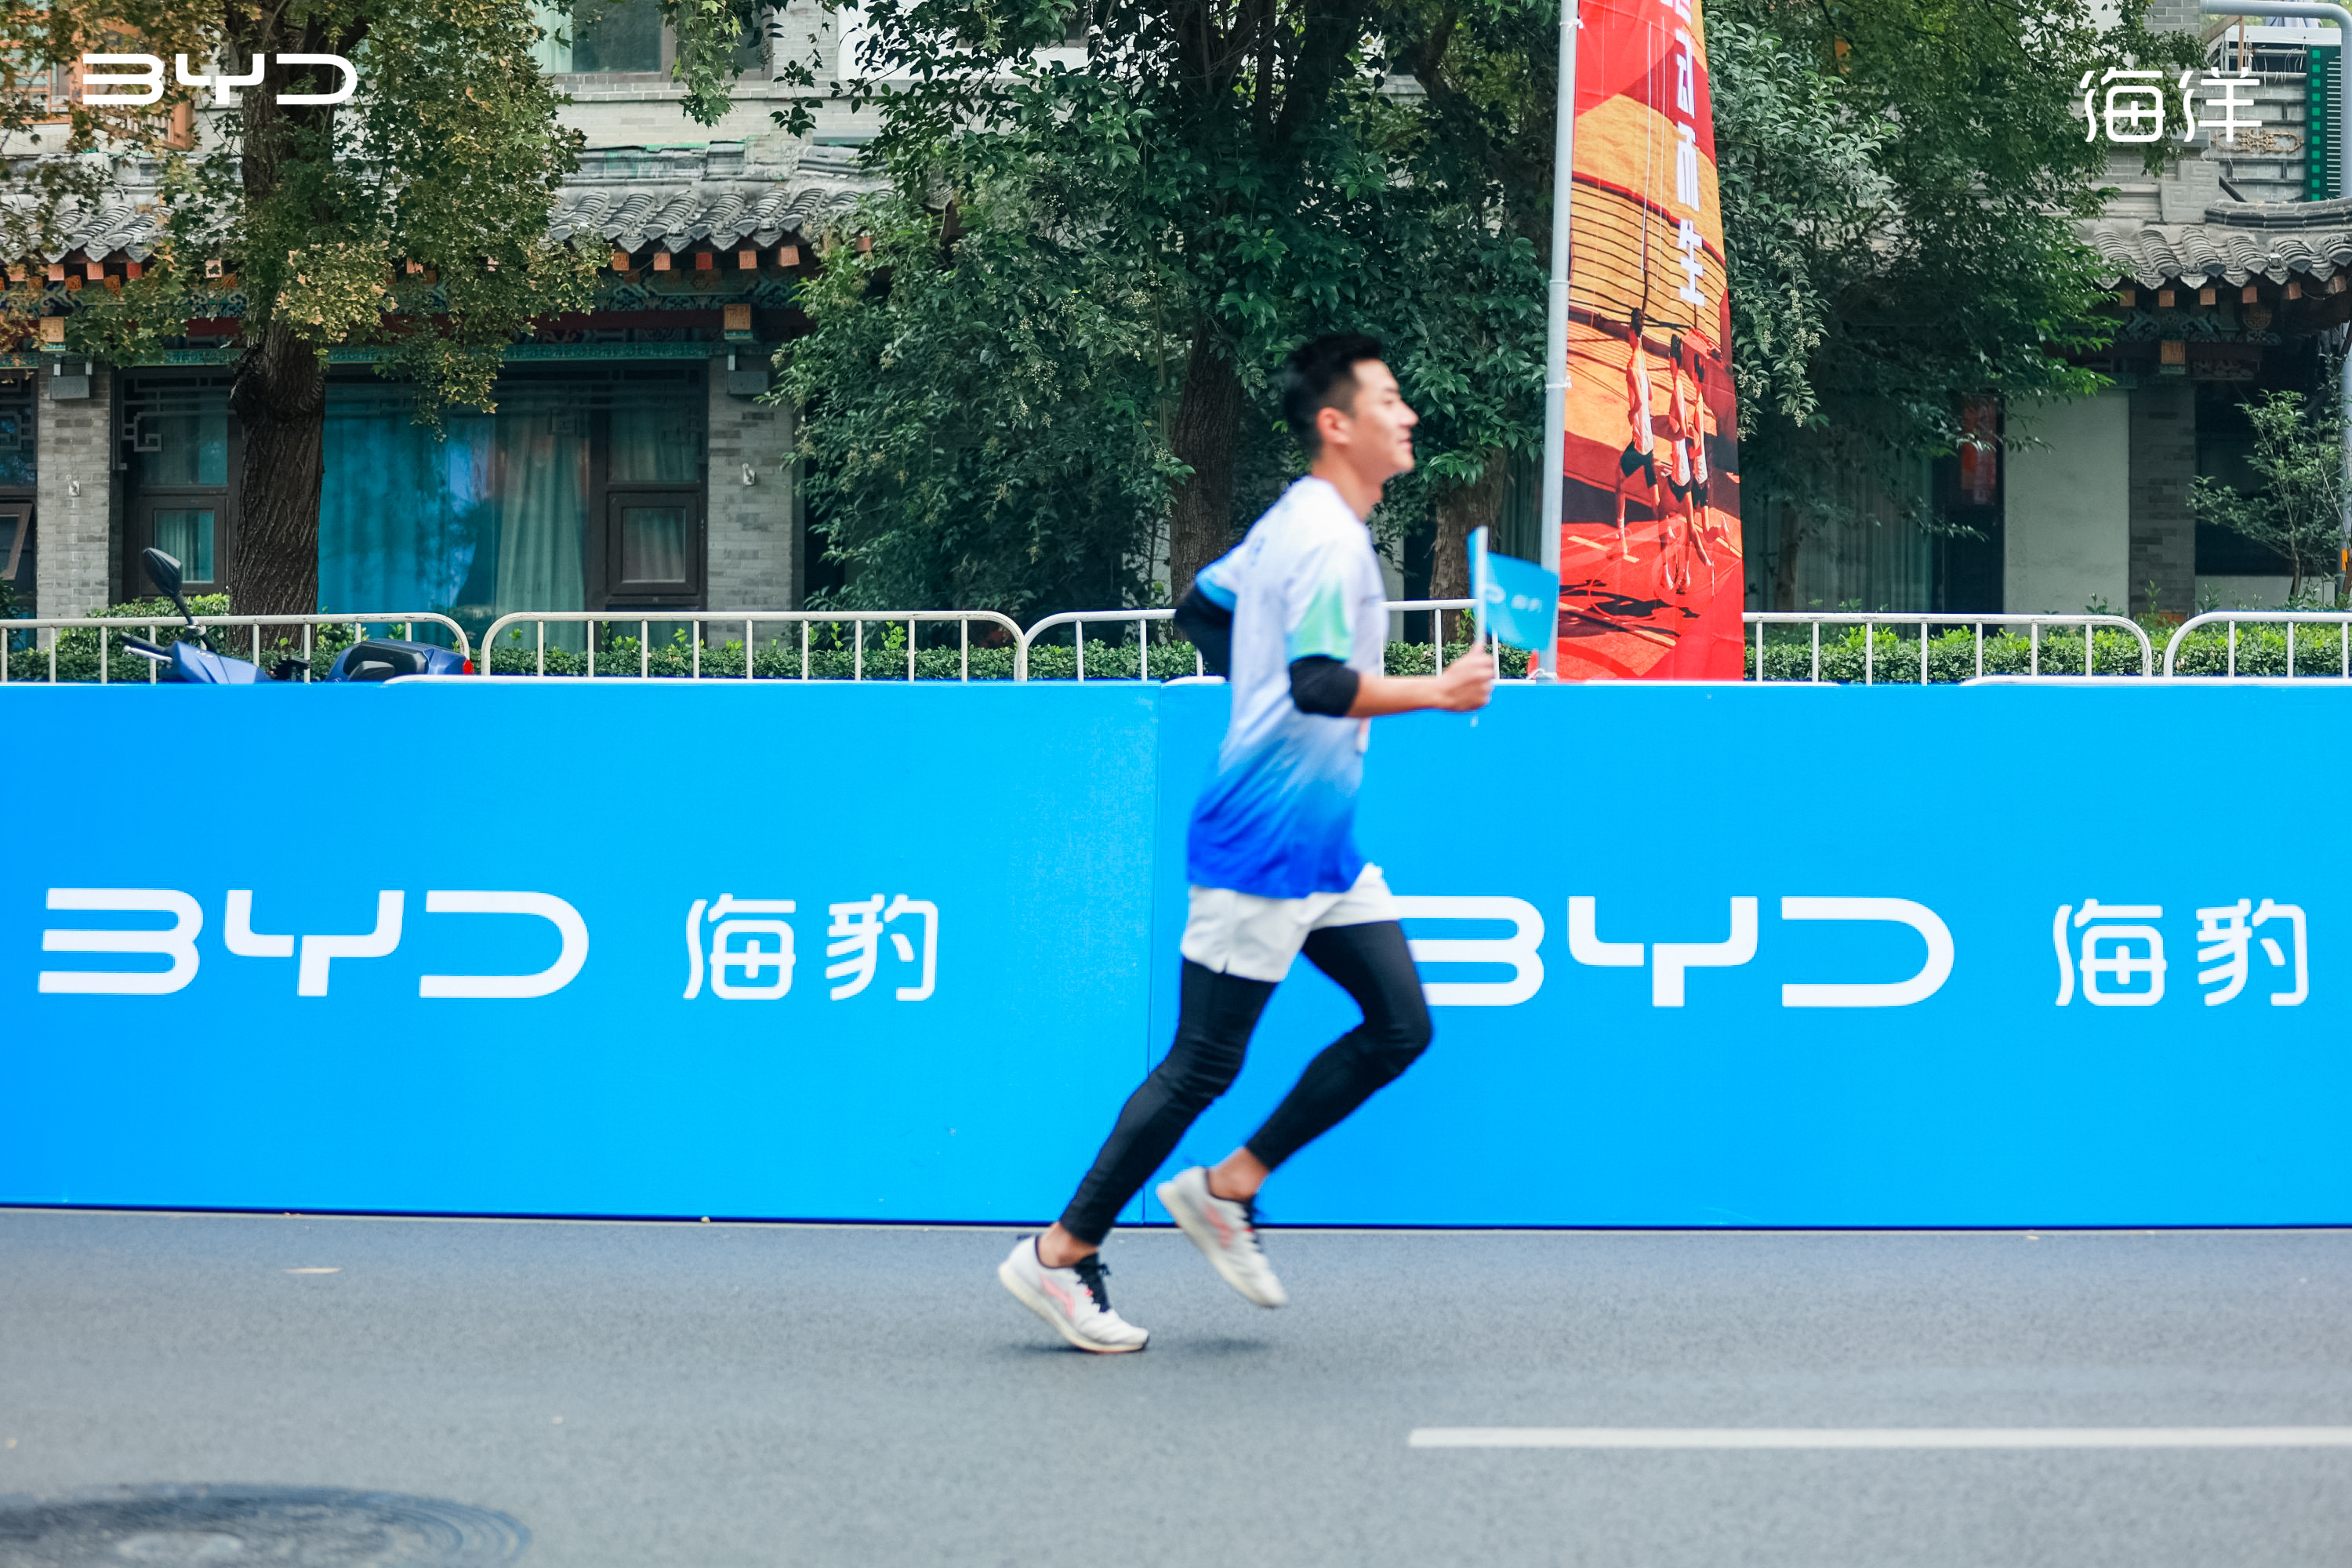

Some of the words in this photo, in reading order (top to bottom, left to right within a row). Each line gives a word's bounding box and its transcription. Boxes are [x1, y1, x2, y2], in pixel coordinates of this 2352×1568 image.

[38, 887, 590, 999] BYD
[683, 894, 939, 1002] 海豹
[1391, 895, 1955, 1007] BYD
[2053, 898, 2309, 1007] 海豹
